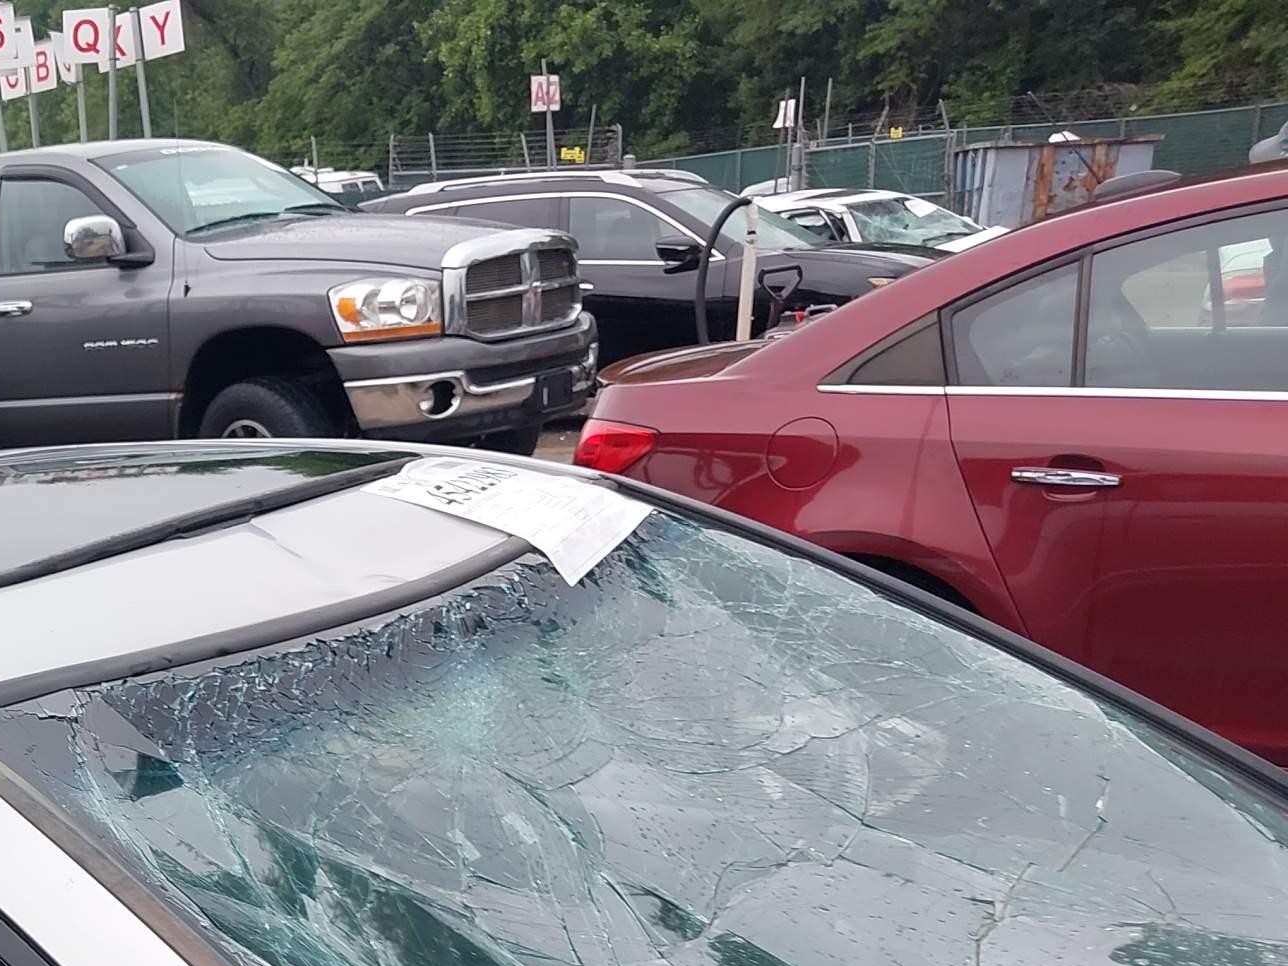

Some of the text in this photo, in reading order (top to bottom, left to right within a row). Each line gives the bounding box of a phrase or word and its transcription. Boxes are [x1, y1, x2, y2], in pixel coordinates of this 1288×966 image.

[72, 19, 100, 54] Q
[150, 11, 171, 46] Y
[35, 50, 50, 83] B
